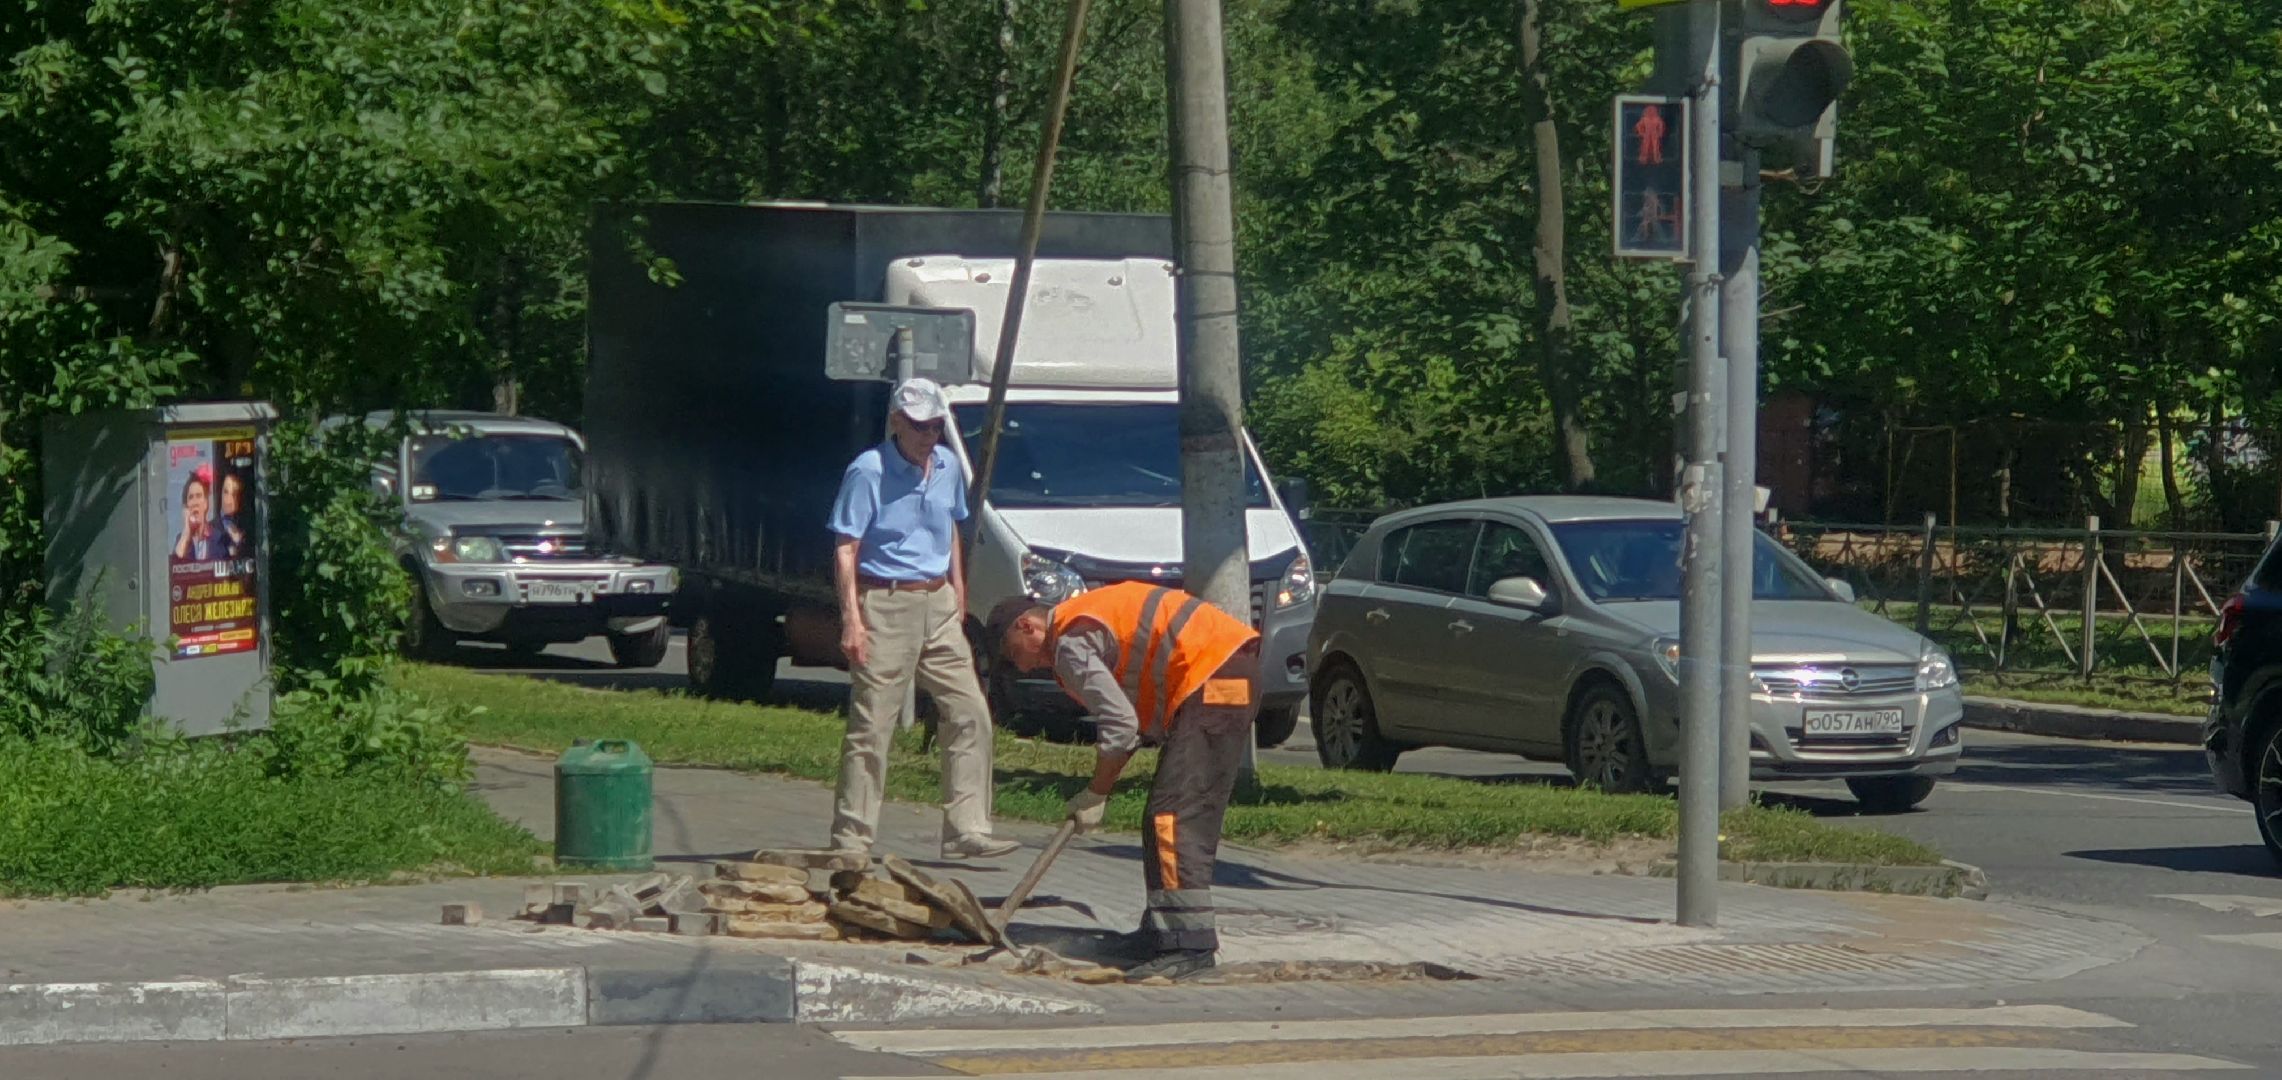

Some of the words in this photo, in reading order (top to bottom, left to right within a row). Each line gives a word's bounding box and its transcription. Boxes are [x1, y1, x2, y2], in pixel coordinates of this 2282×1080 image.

[214, 559, 255, 577] ШАНС
[187, 583, 212, 600] АНДРЕЙ
[173, 603, 202, 625] ОЛЕСЯ
